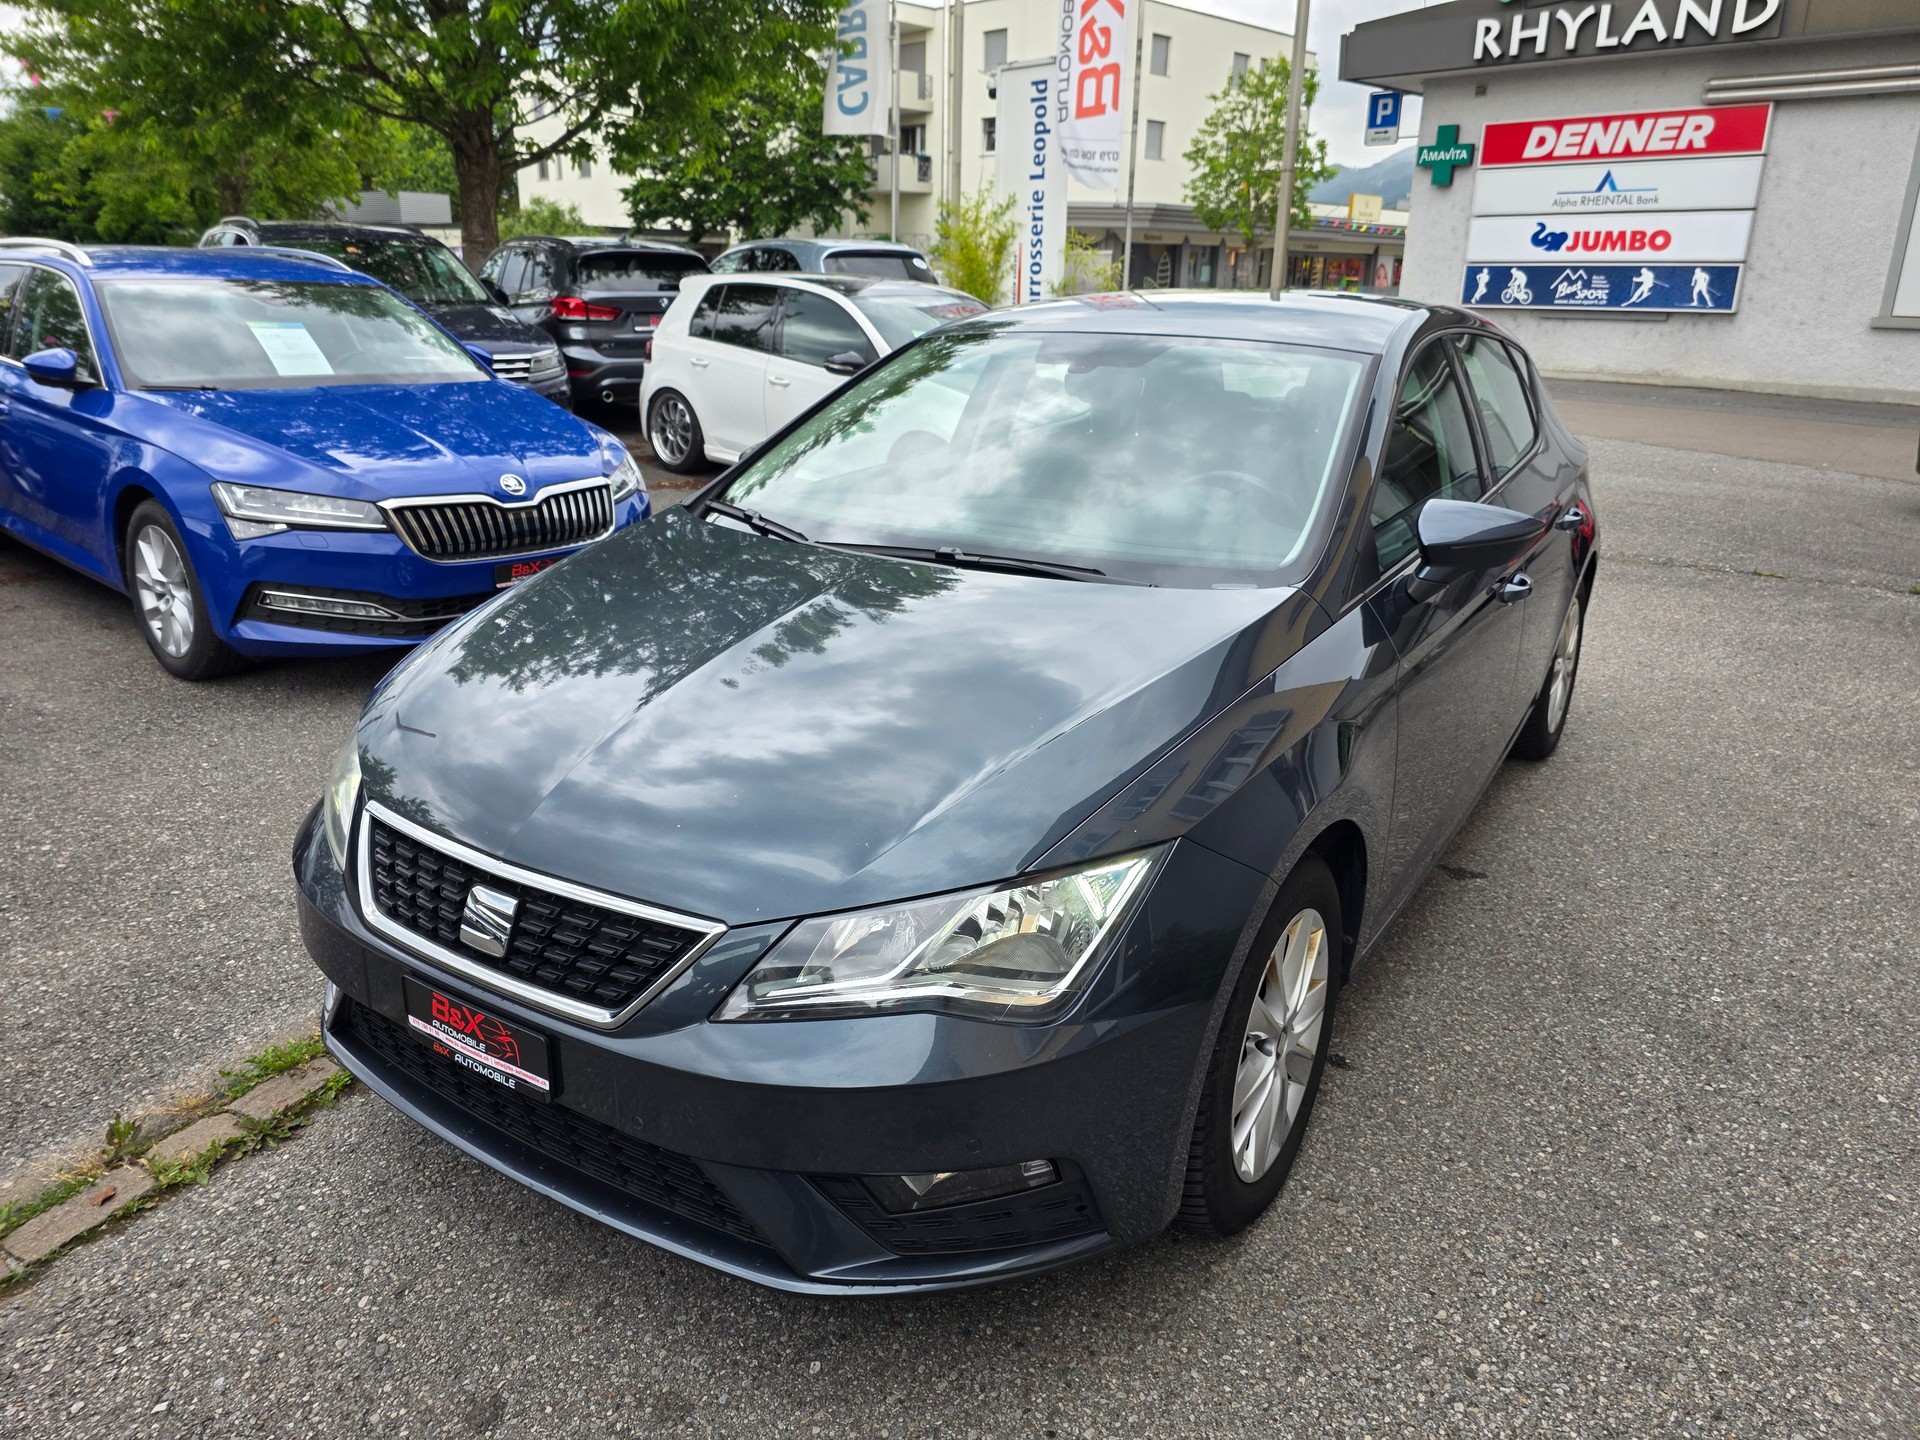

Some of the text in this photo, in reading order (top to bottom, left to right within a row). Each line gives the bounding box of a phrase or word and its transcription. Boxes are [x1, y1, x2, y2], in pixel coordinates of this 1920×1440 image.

[1473, 0, 1780, 60] RHYLAND
[1376, 98, 1393, 125] P
[1029, 79, 1051, 181] Leopold
[1521, 115, 1715, 159] DENNER
[1552, 194, 1659, 209] Alpha RHEINTAL Bank
[1565, 230, 1672, 252] JUMBO
[432, 992, 486, 1041] B&X
[432, 1019, 486, 1052] AUTOMOBILE
[454, 1053, 516, 1089] AUTOMOBILE
